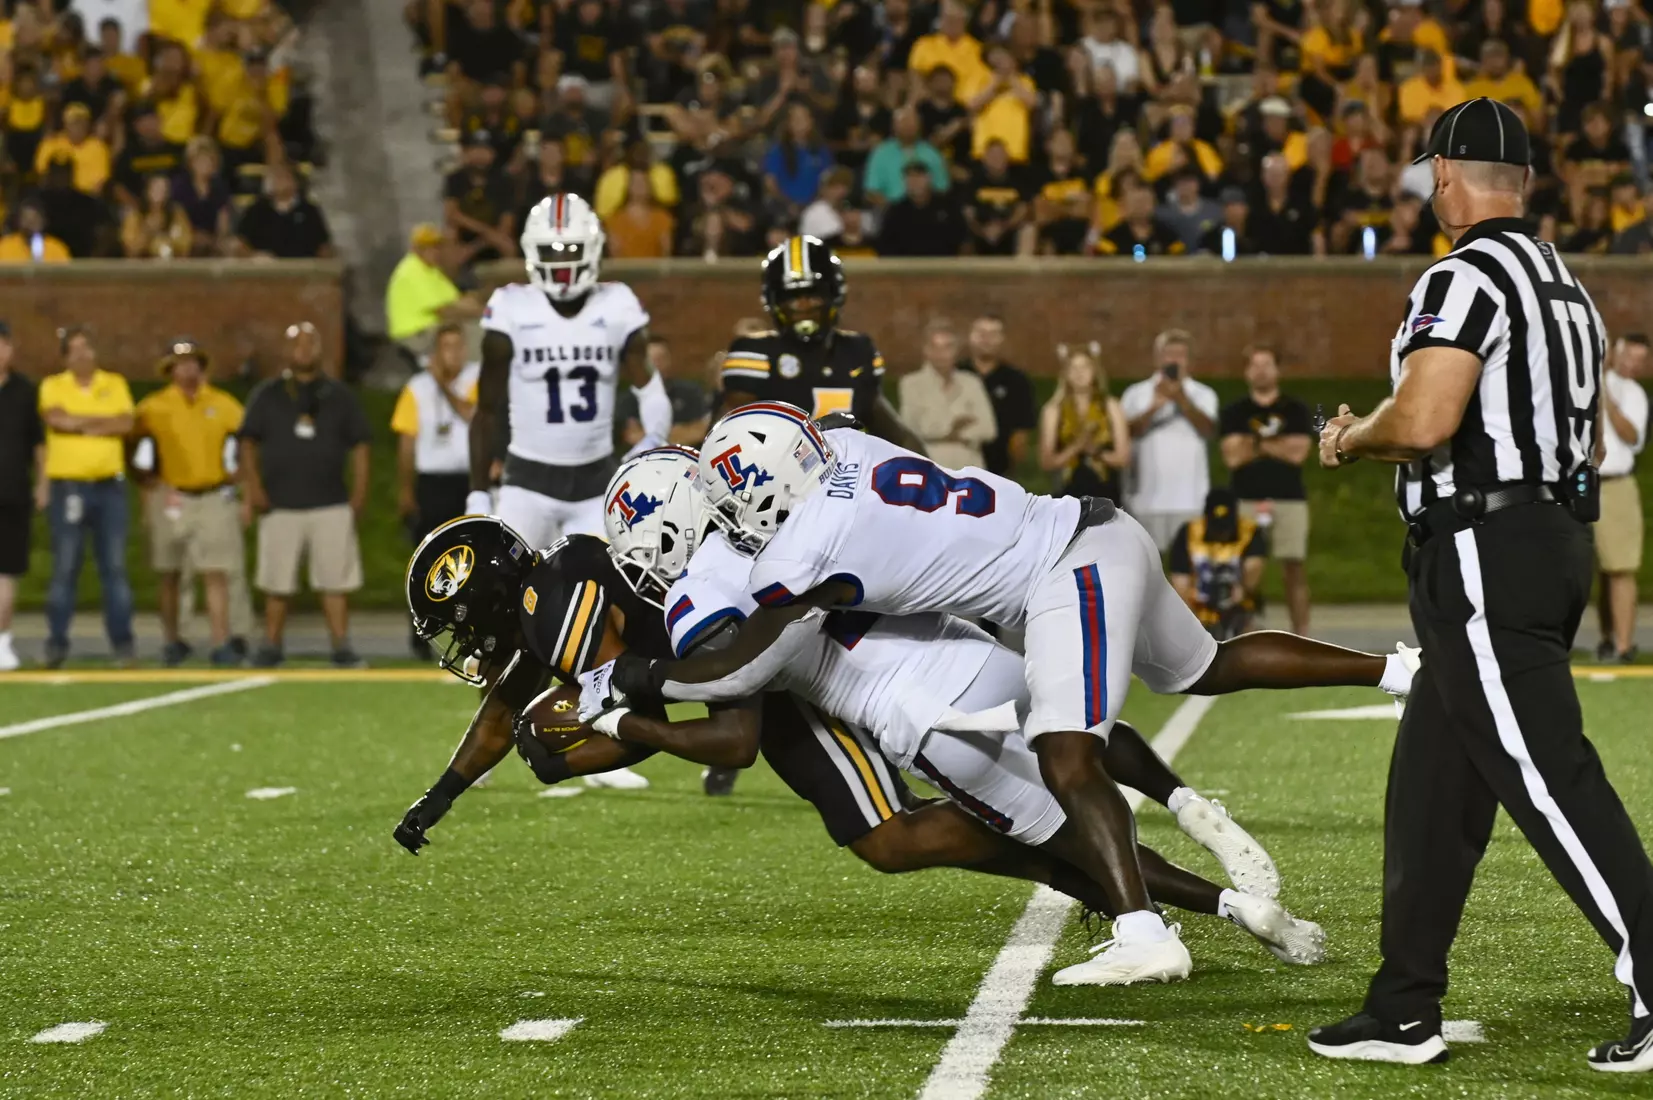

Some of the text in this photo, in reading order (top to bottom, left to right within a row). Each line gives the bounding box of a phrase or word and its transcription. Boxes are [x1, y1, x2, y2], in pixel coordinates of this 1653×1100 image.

[1550, 299, 1596, 410] U
[543, 365, 599, 423] 13
[827, 462, 859, 499] DAVIS
[871, 456, 996, 518] 9
